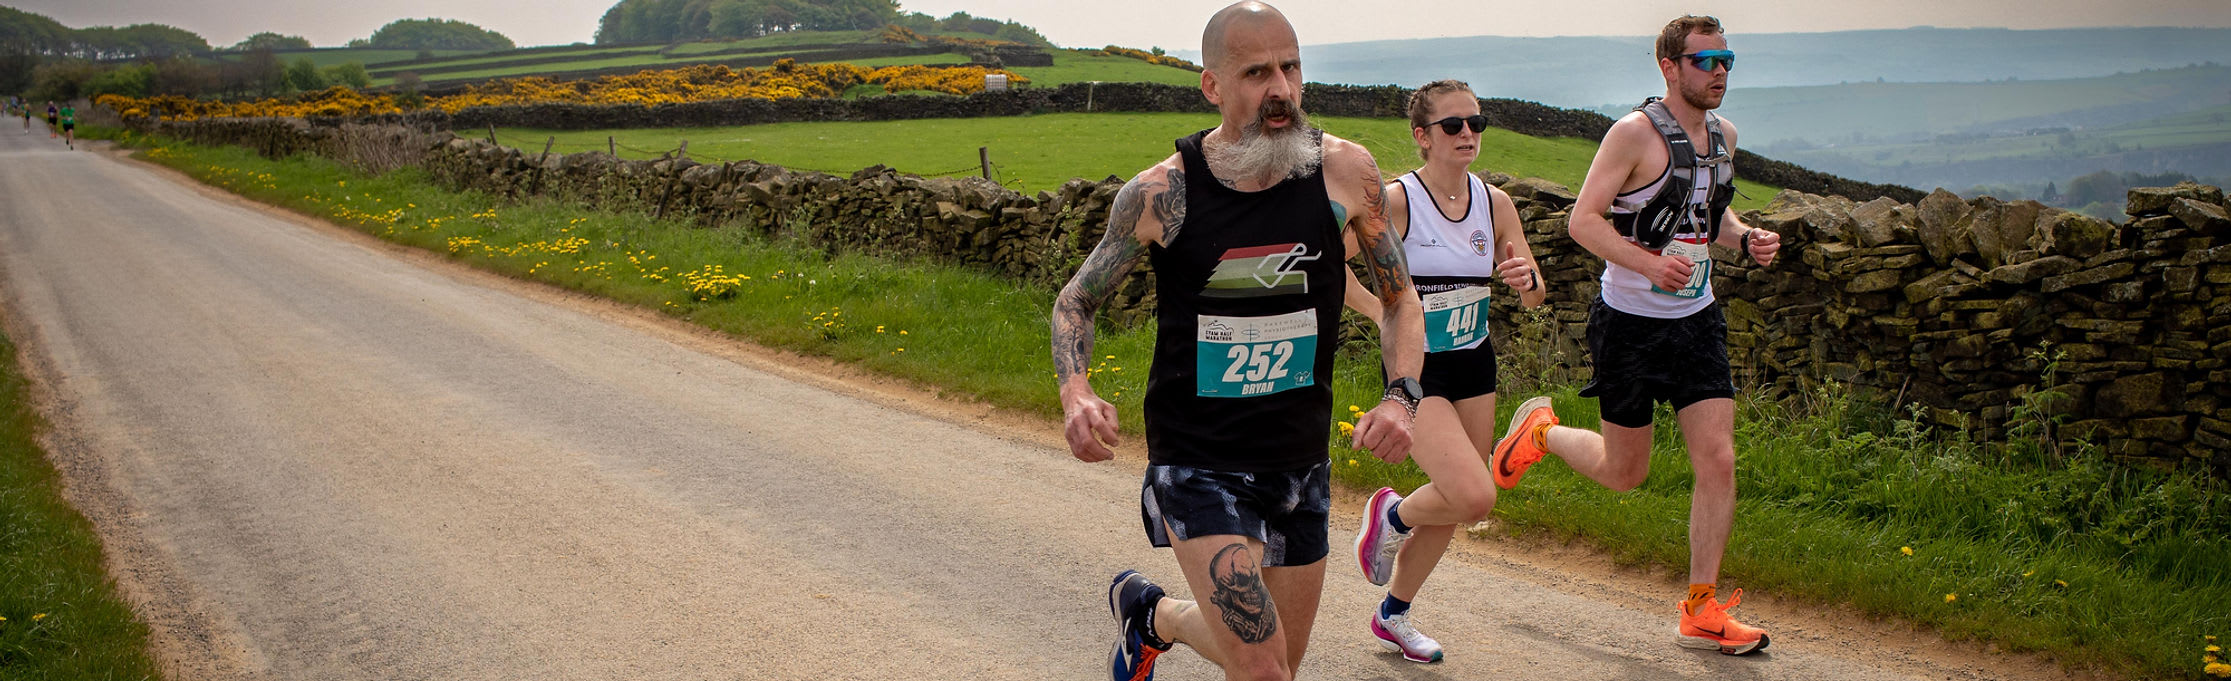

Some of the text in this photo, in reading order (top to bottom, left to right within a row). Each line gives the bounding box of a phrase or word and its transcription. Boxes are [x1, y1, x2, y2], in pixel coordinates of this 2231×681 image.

[1415, 283, 1454, 292] RONFIELD
[1446, 301, 1479, 337] 441
[1221, 340, 1294, 382] 252
[1241, 381, 1275, 395] BRYAN
